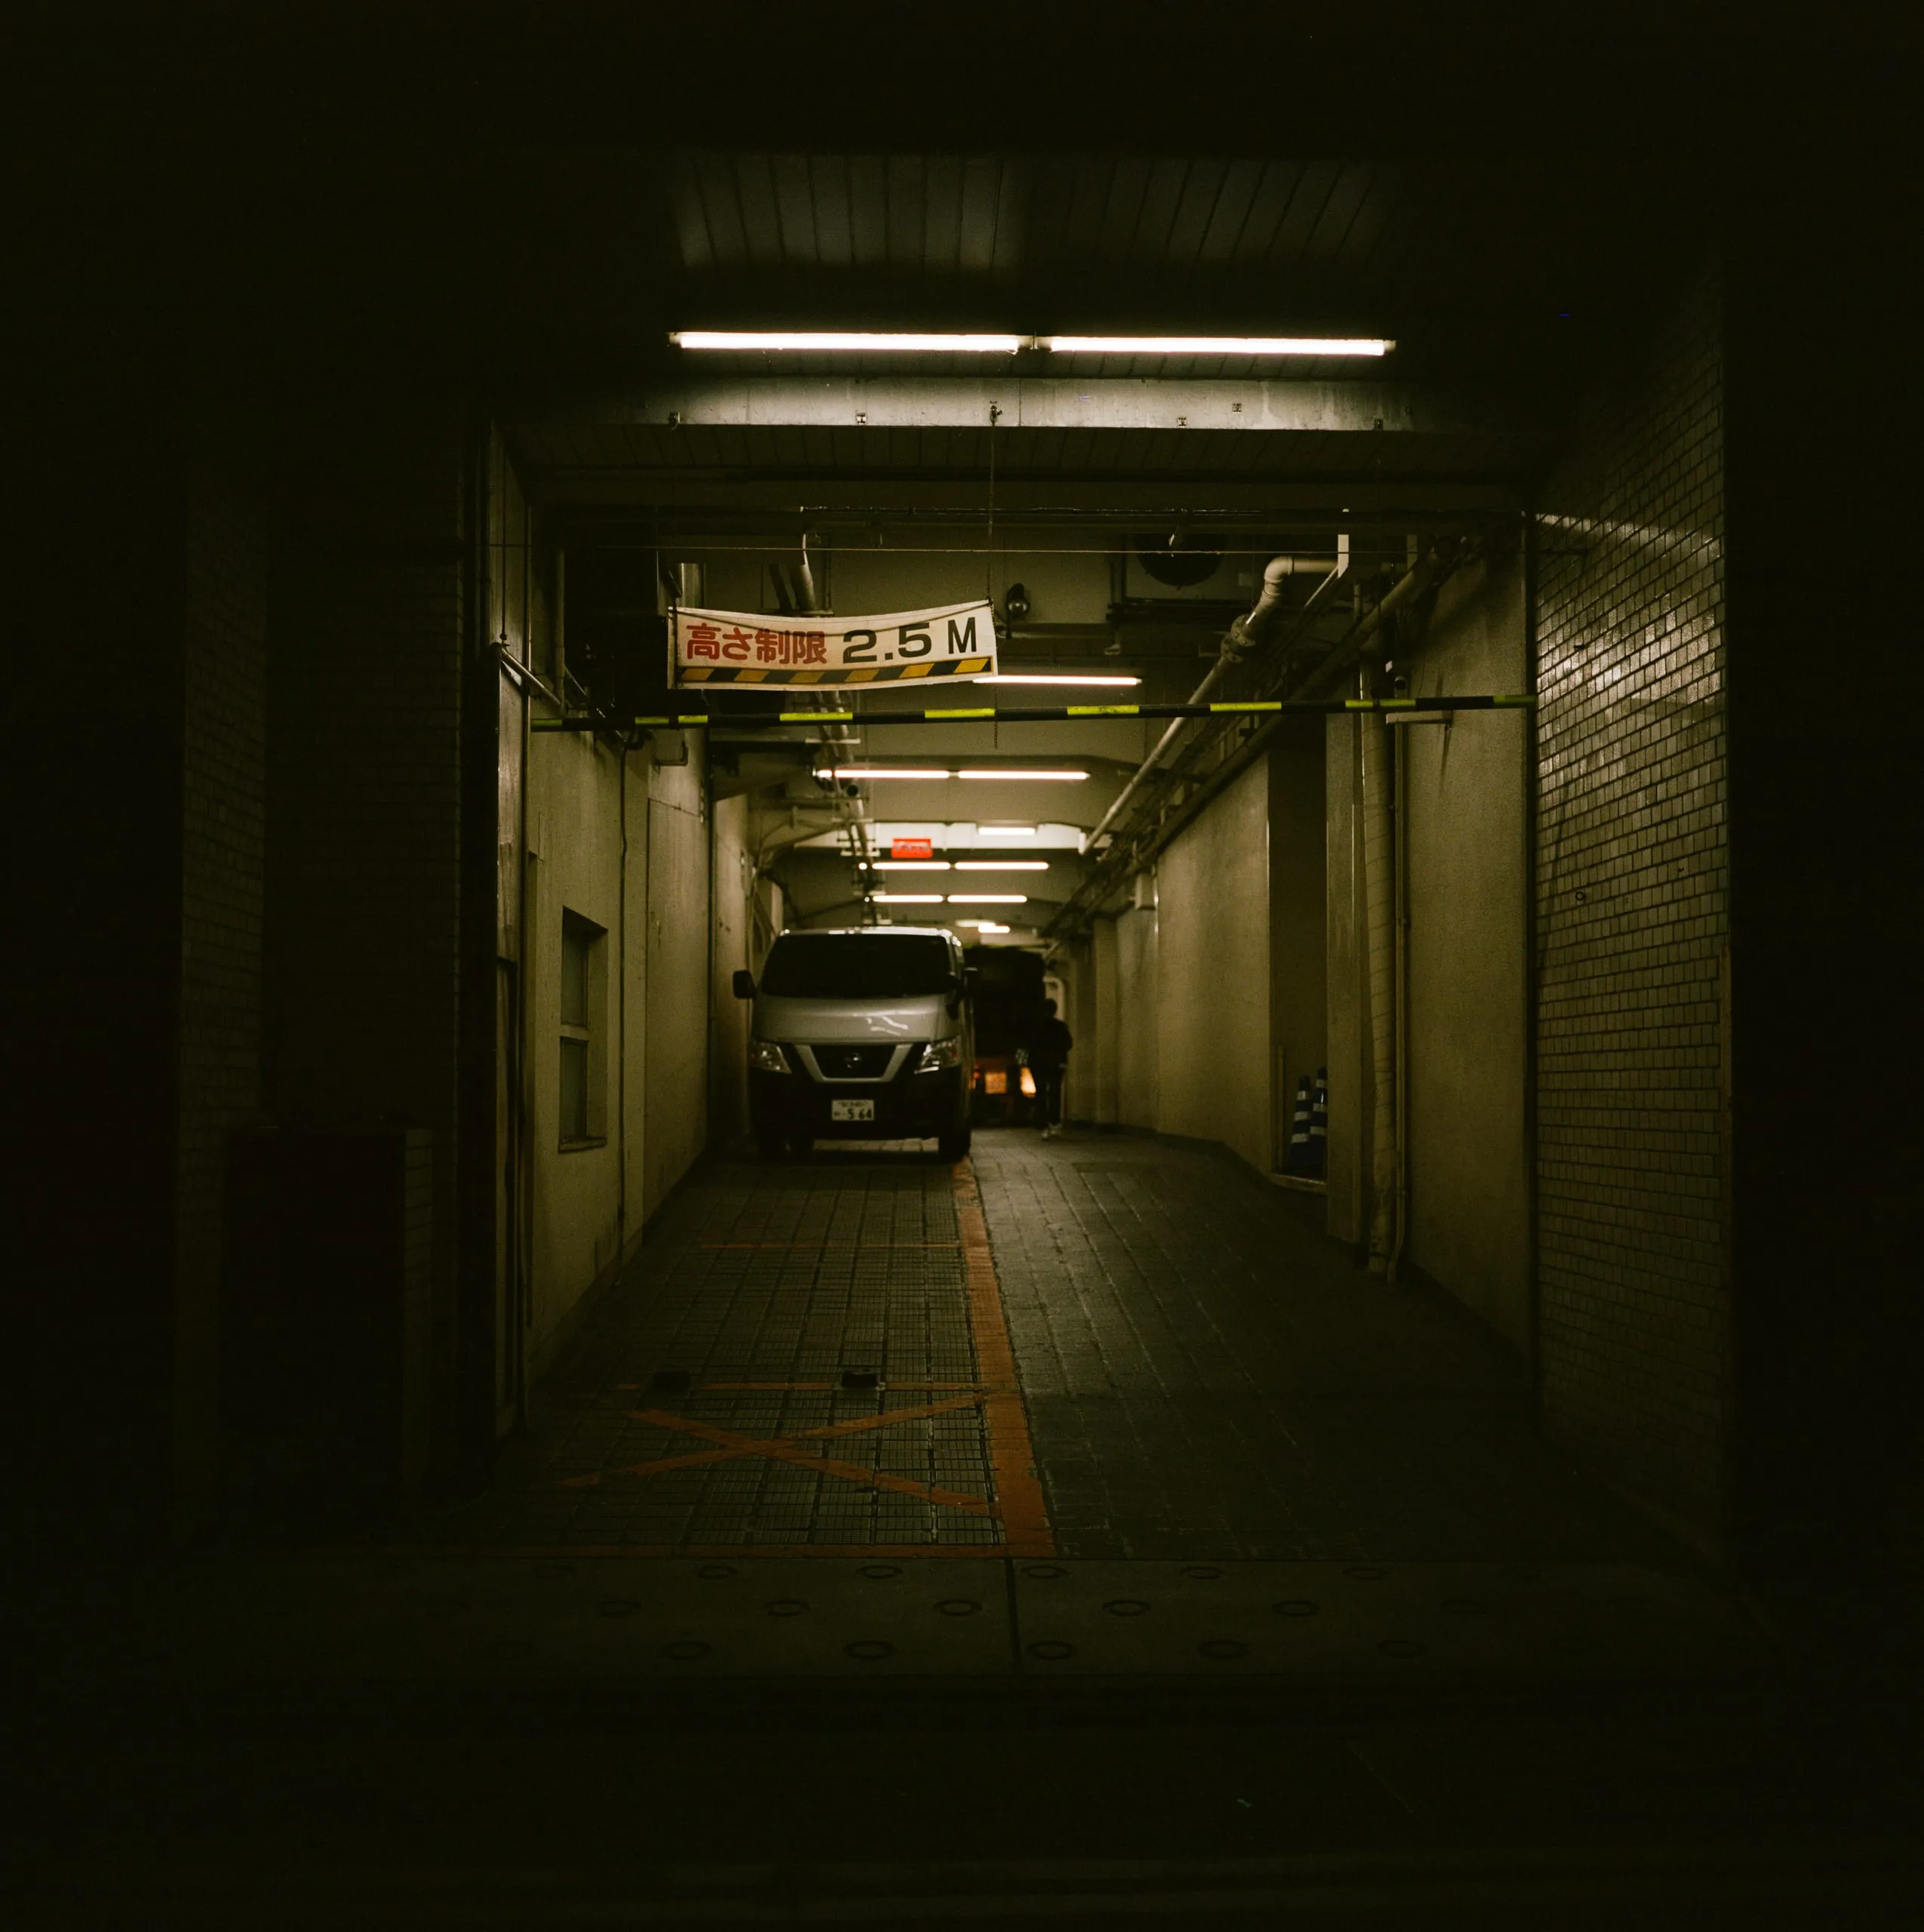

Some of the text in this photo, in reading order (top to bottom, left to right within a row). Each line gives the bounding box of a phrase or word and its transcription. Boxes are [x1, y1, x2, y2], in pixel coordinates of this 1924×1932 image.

[687, 617, 978, 664] 高さ制限 2.5 M
